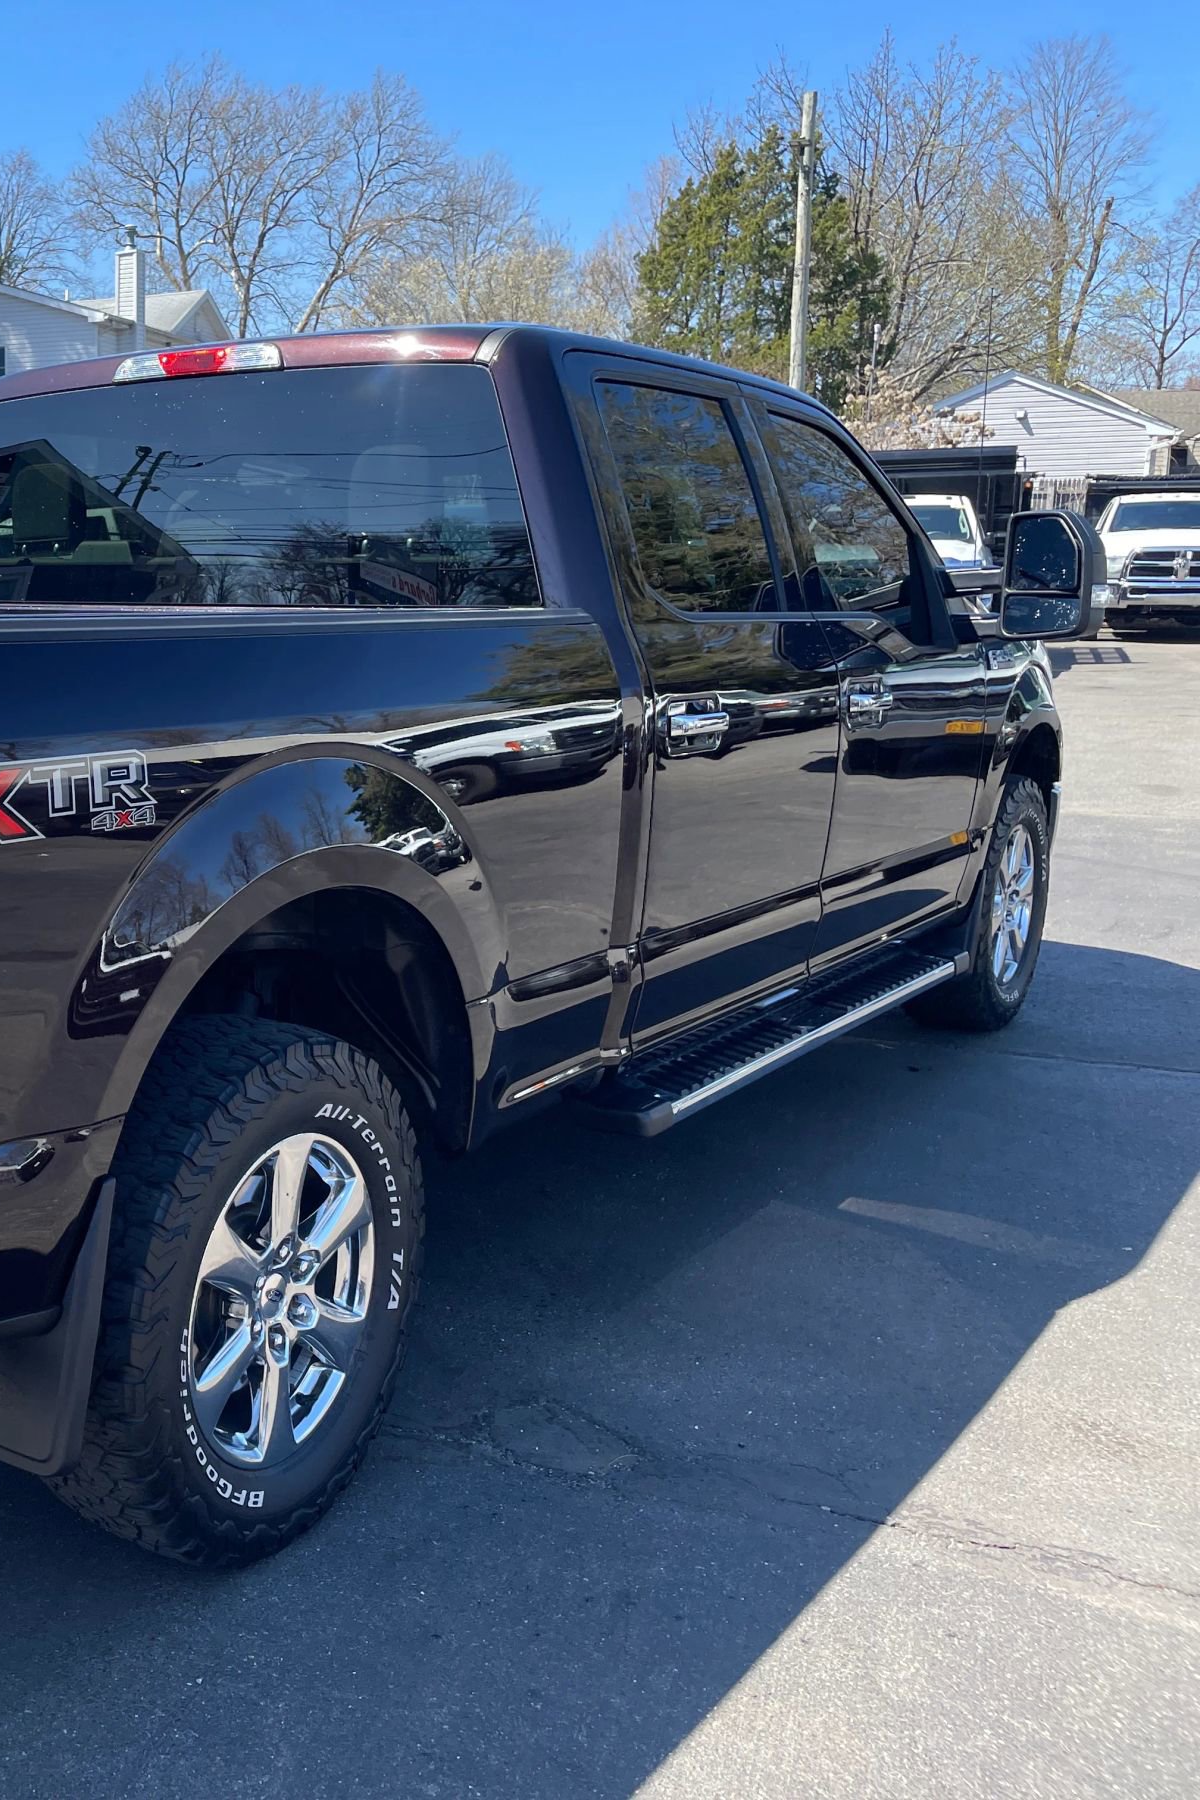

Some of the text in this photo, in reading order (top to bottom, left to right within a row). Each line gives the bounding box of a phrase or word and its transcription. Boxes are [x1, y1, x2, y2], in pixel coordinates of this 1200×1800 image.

[91, 805, 157, 832] 4x4
[314, 1102, 405, 1310] All-Terrain T/A
[179, 1327, 265, 1508] BFGoodrich
